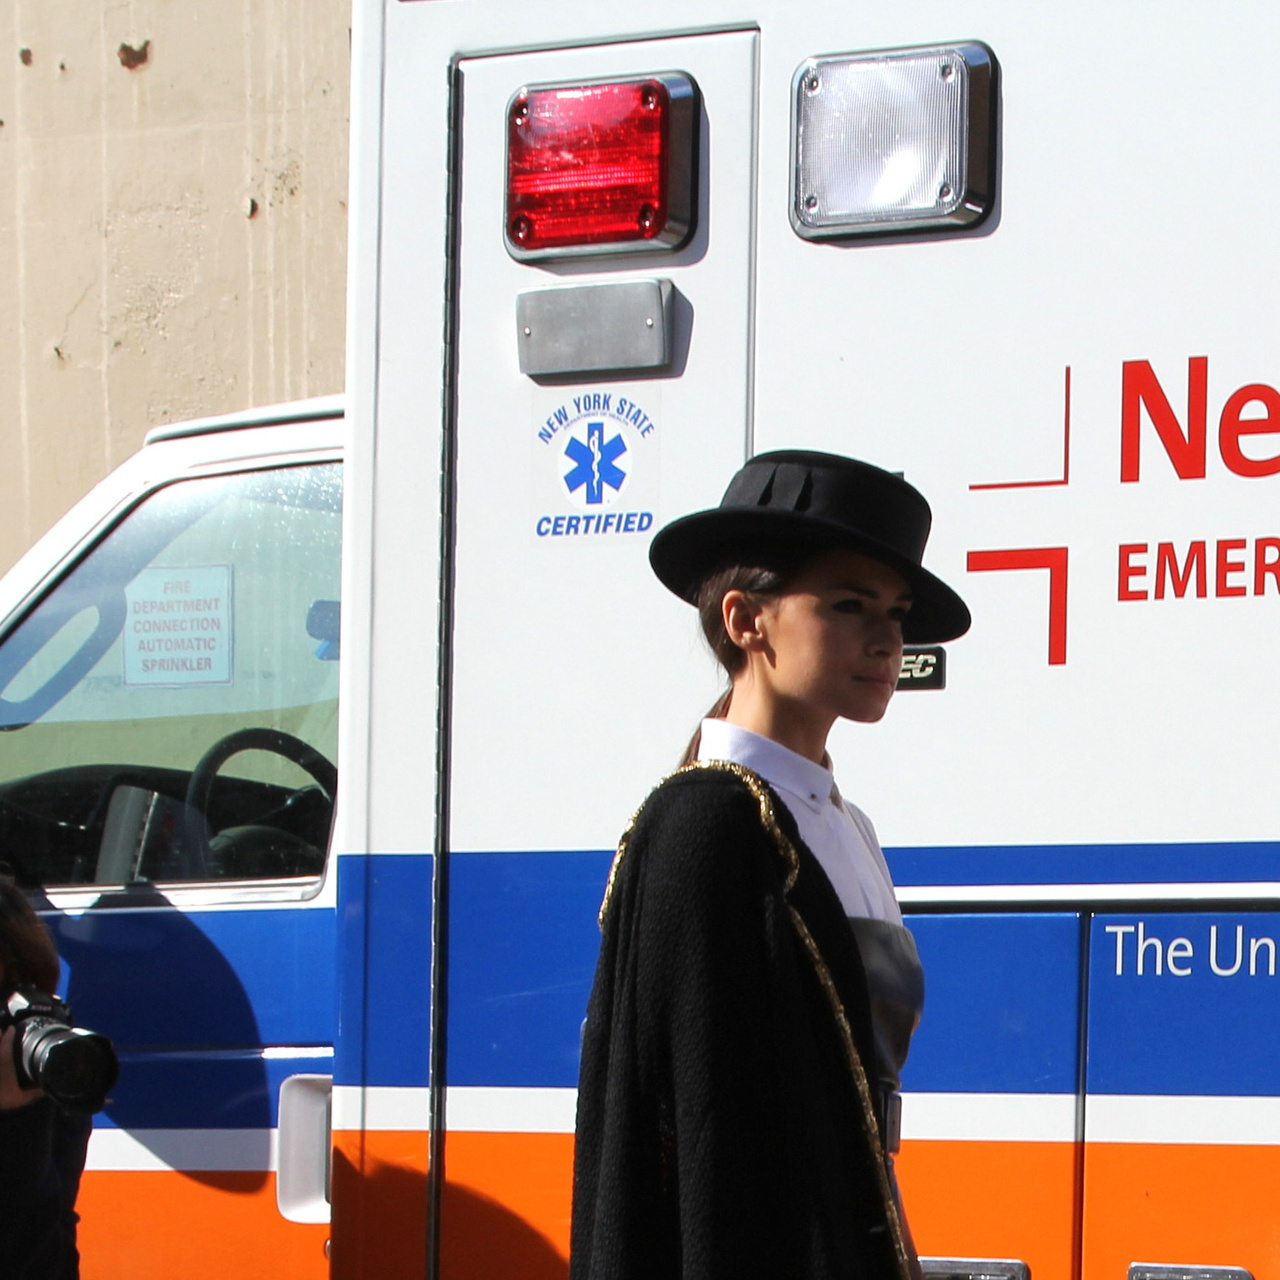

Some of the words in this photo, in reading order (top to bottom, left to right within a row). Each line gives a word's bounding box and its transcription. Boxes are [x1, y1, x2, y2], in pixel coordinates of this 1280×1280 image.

[537, 405, 569, 445] NEW
[573, 393, 612, 414] YORK
[616, 397, 655, 439] STATE
[536, 512, 653, 536] CERTIFIED
[163, 581, 191, 594] FIRE
[133, 598, 221, 614] DEPARTMENT
[133, 618, 221, 633] CONNECTION
[138, 638, 216, 652] AUTOMATIC
[142, 657, 212, 672] SPRINKLER
[1106, 922, 1194, 976] The
